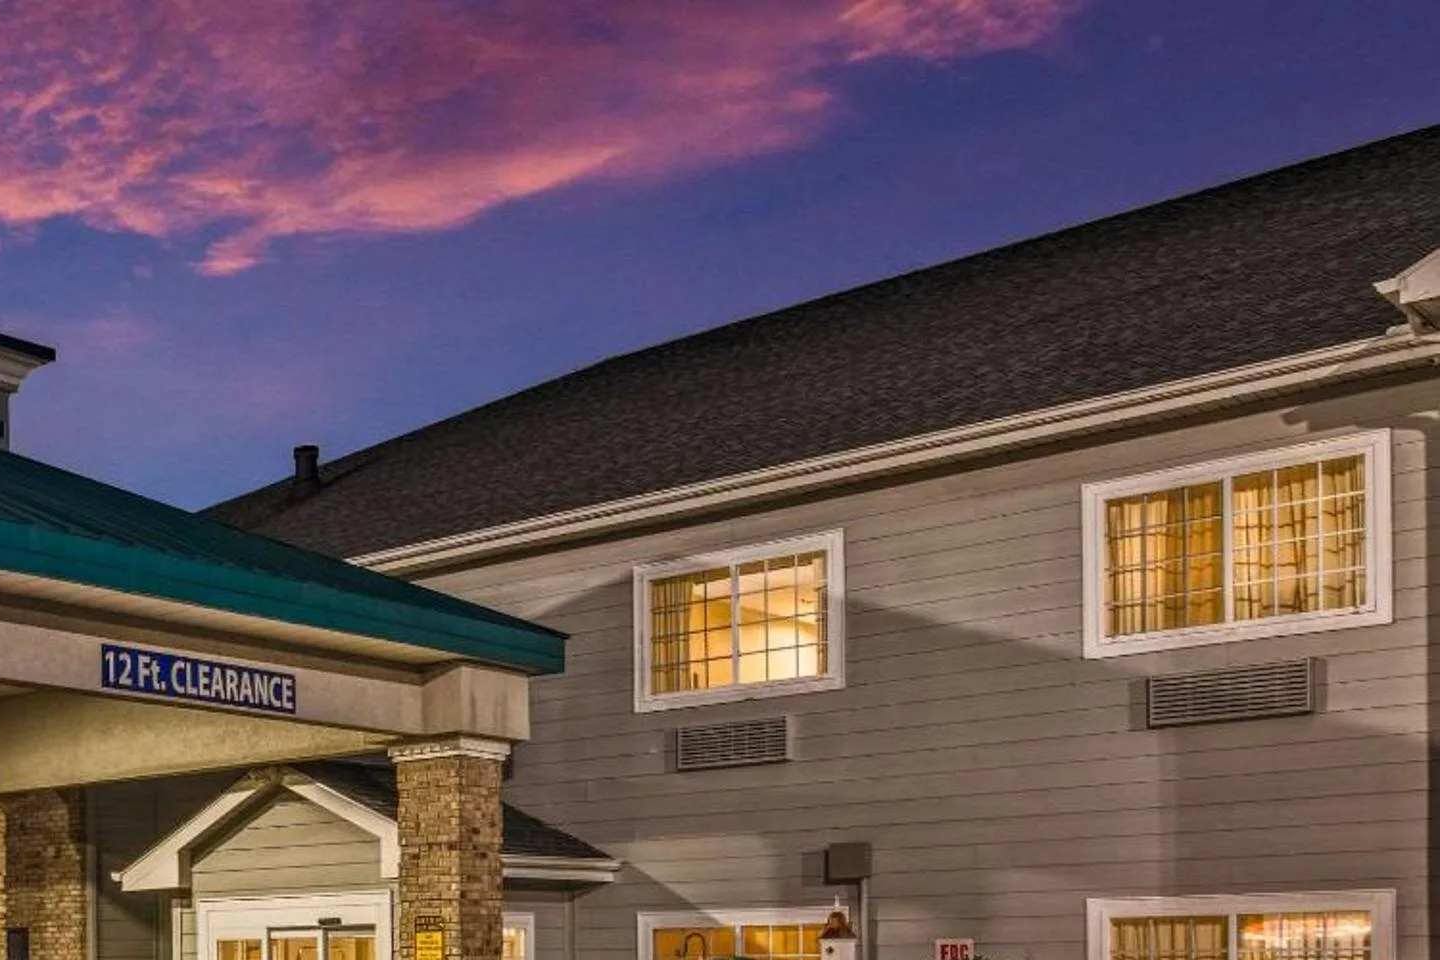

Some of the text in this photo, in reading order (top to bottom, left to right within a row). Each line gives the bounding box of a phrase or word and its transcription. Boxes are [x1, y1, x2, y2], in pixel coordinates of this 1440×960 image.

[104, 650, 294, 710] 12 Ft. CLEARANCE
